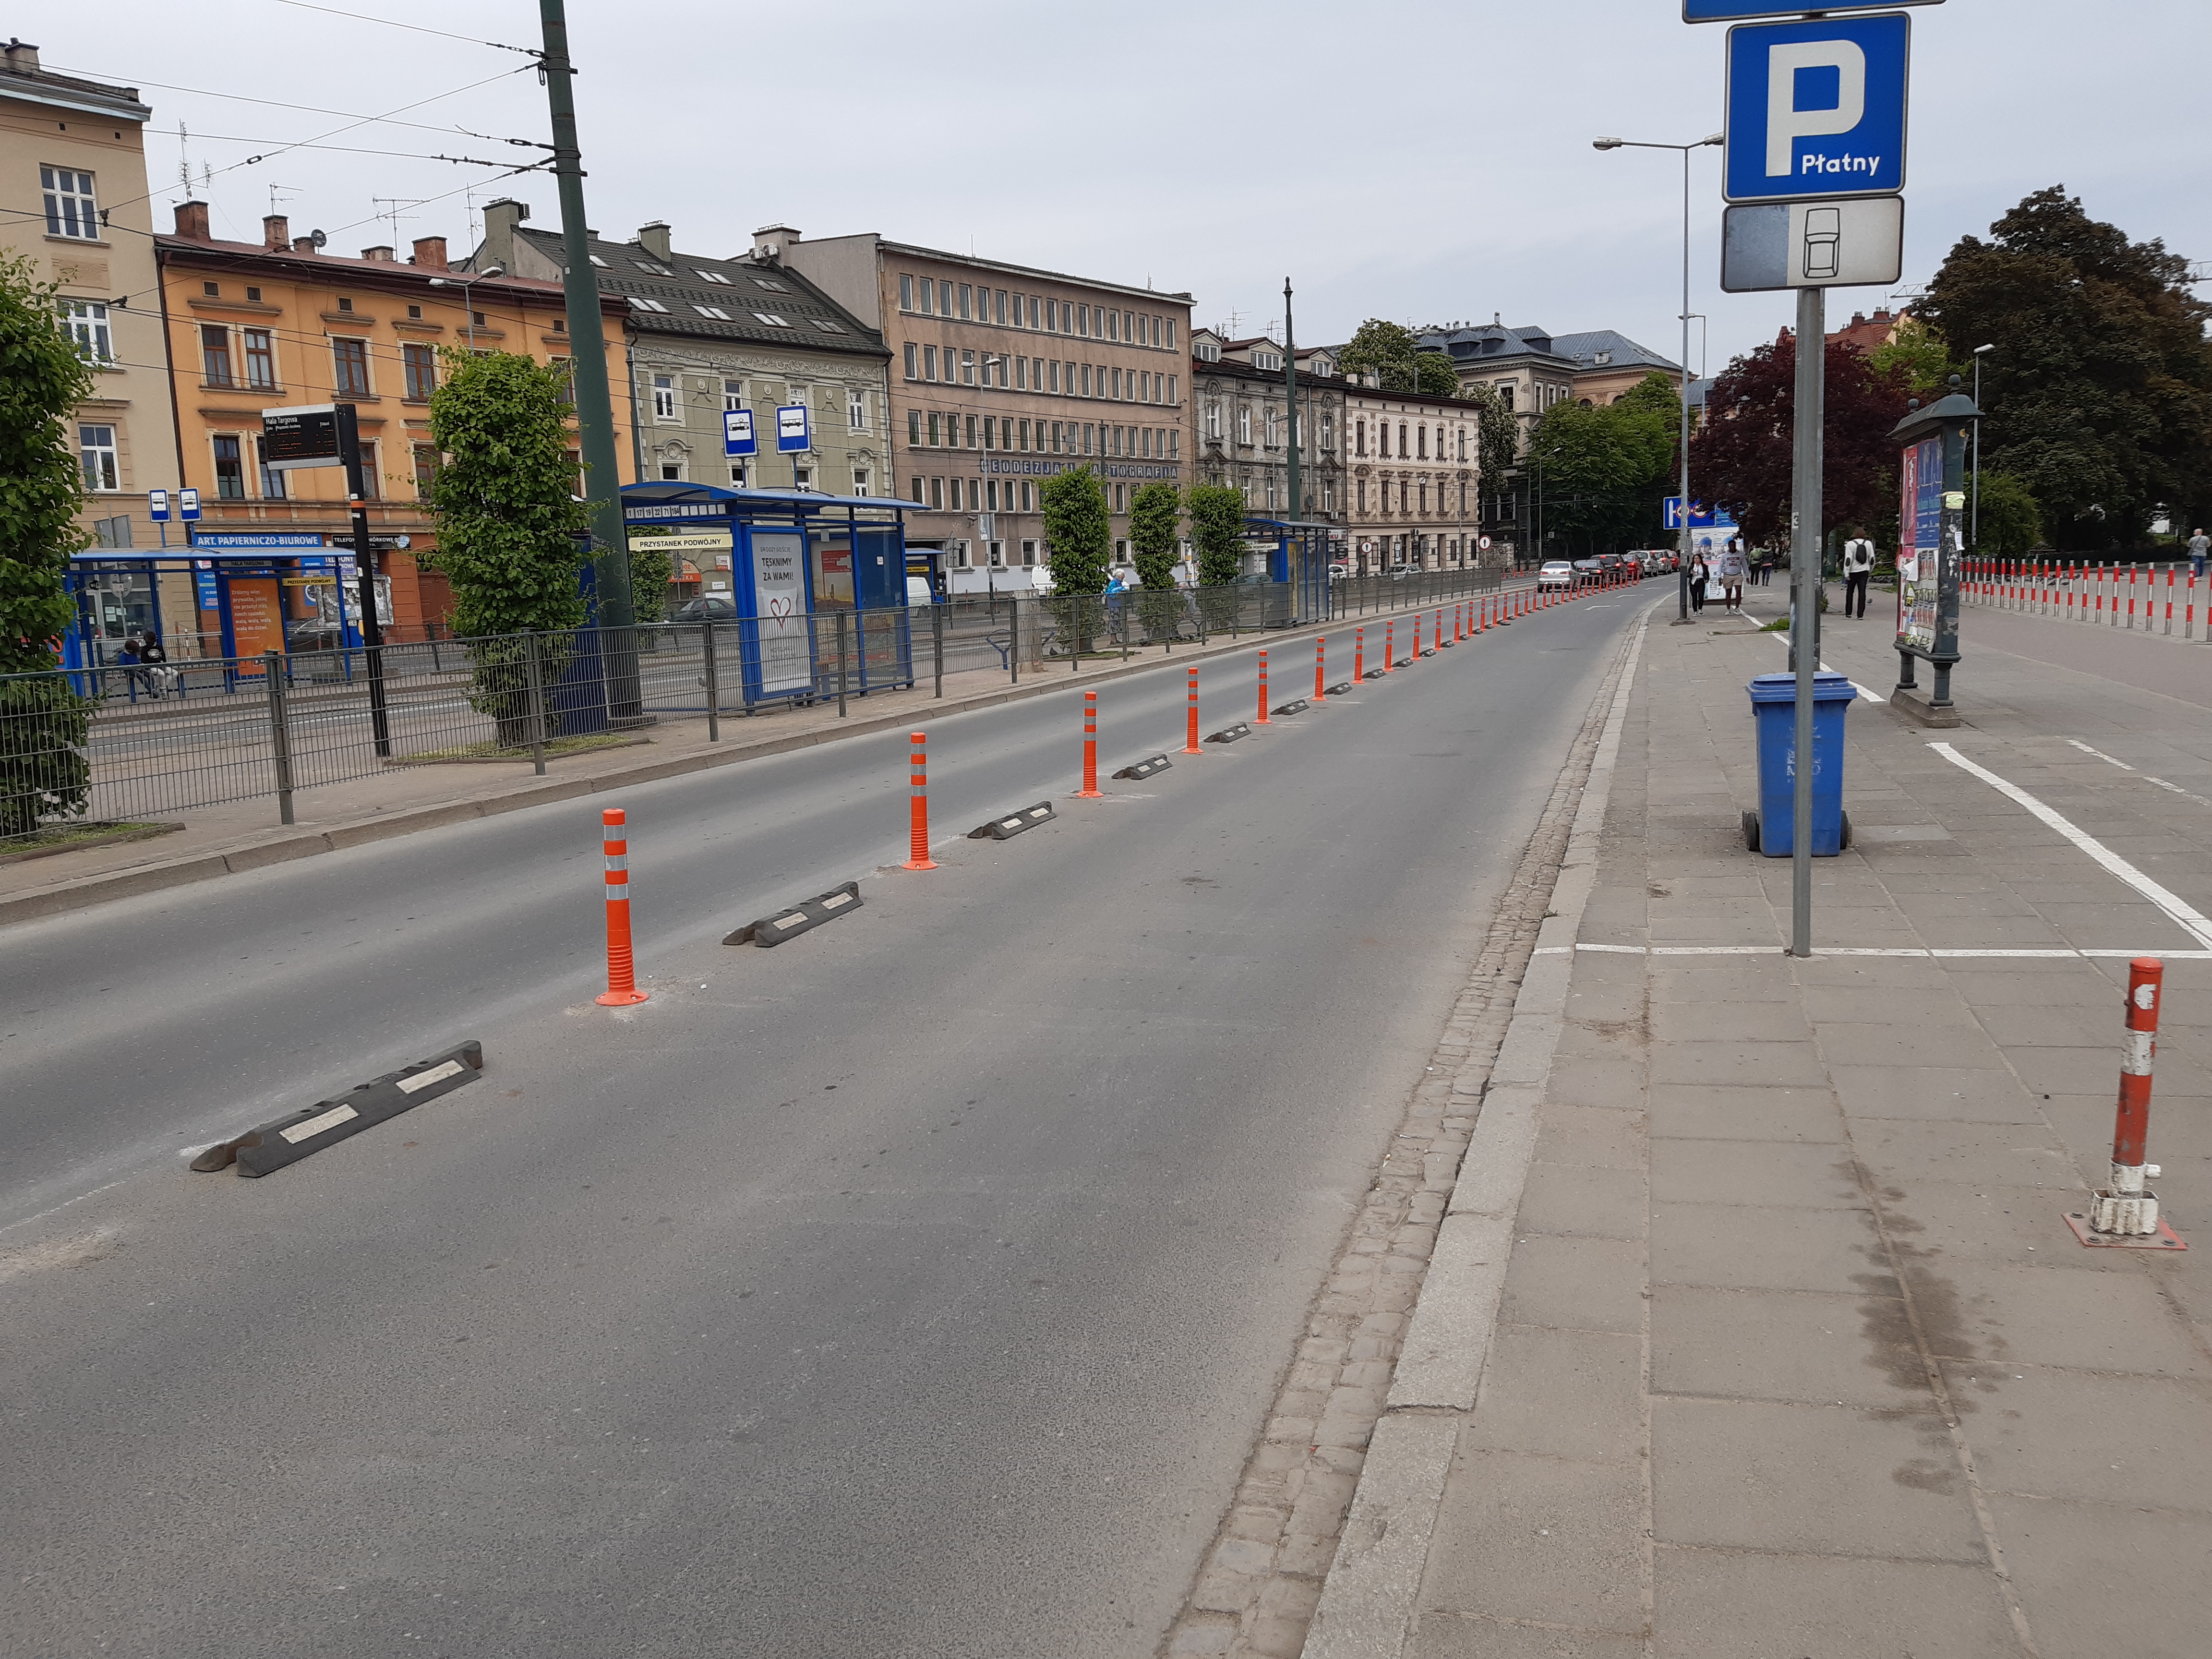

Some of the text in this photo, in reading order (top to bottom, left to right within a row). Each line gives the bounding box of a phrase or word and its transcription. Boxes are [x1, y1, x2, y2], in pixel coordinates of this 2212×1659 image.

[1766, 40, 1865, 176] P
[1802, 153, 1880, 176] Płatny
[198, 536, 318, 545] ART. PAPIERNICZO-BIUROWE
[684, 538, 721, 546] PODWÓJNY
[762, 558, 792, 568] TĘSKNIMY
[763, 572, 793, 581] ZA WAMI!
